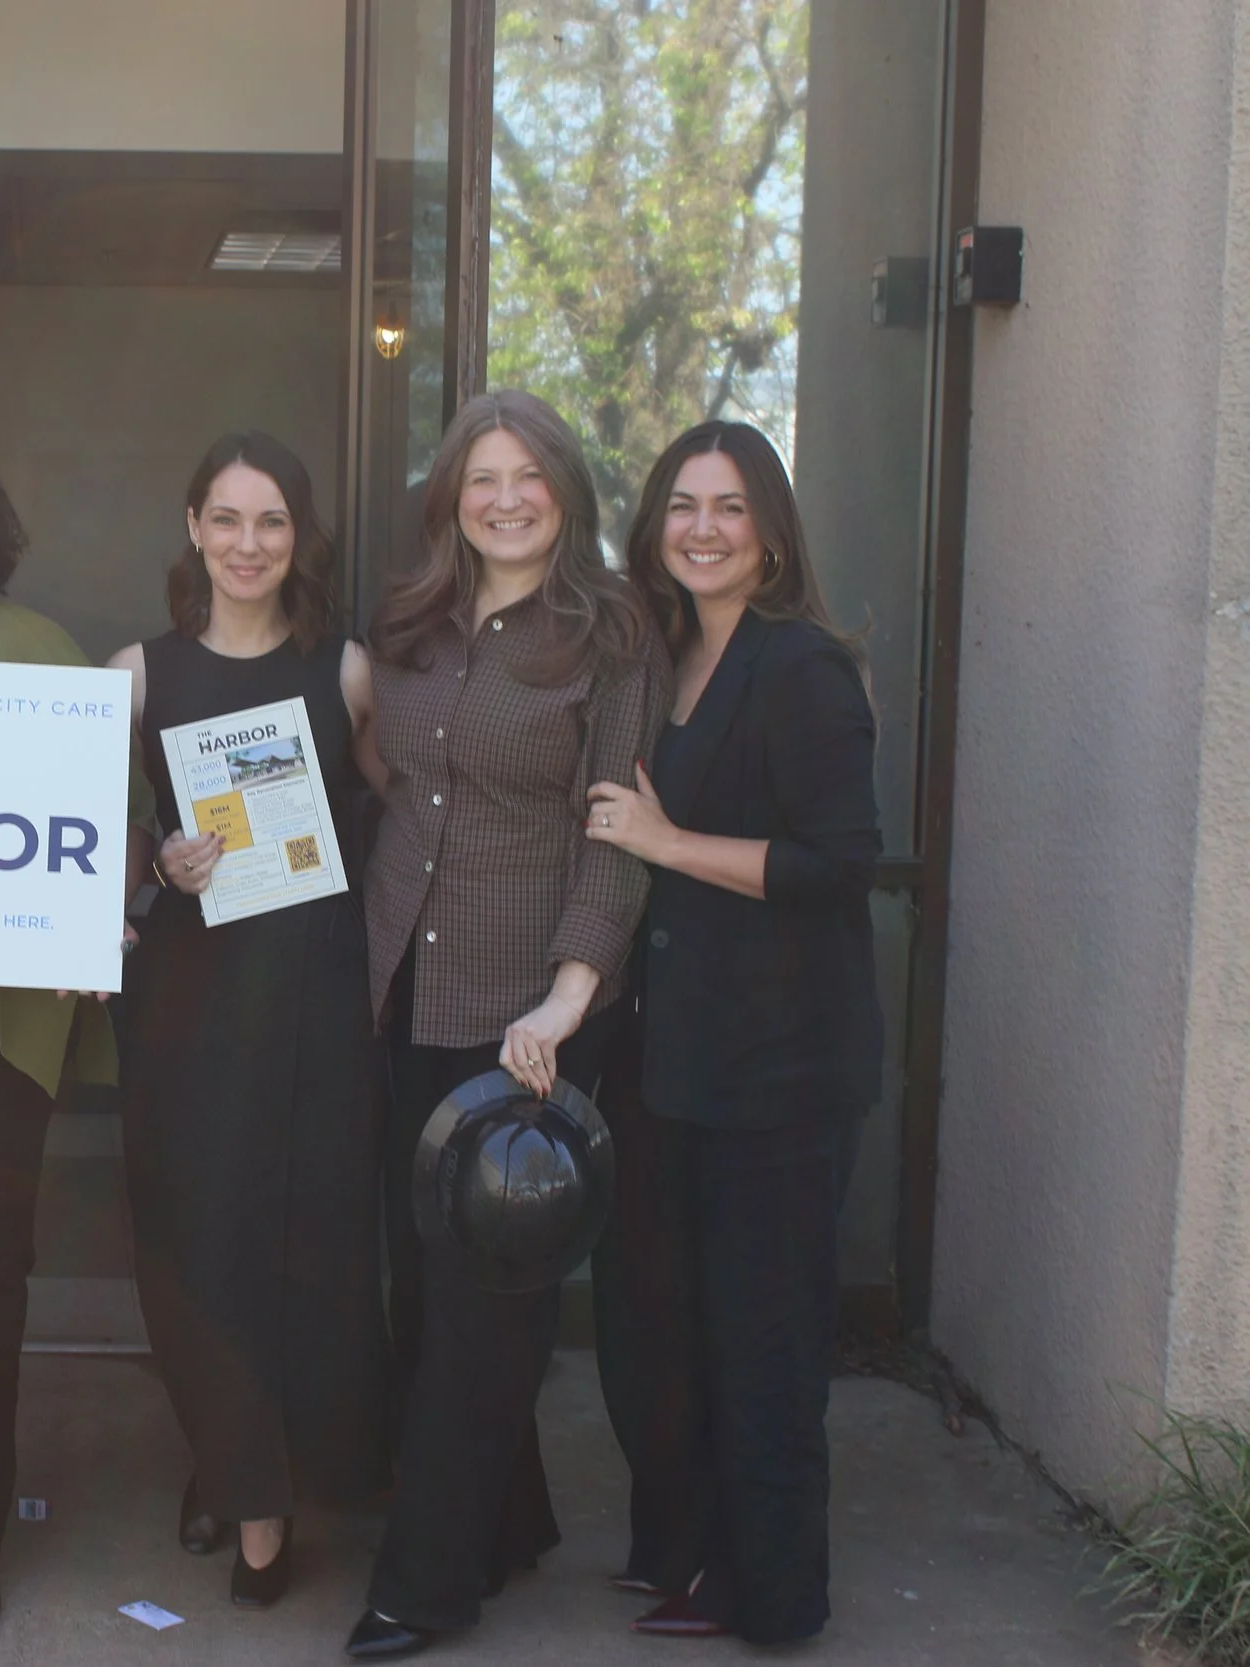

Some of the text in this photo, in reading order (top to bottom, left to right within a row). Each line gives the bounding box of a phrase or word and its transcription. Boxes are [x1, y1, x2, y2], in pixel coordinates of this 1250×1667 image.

[51, 700, 114, 718] CARE
[197, 730, 212, 738] THE
[198, 724, 278, 754] HARBOR
[3, 914, 54, 931] HERE.
